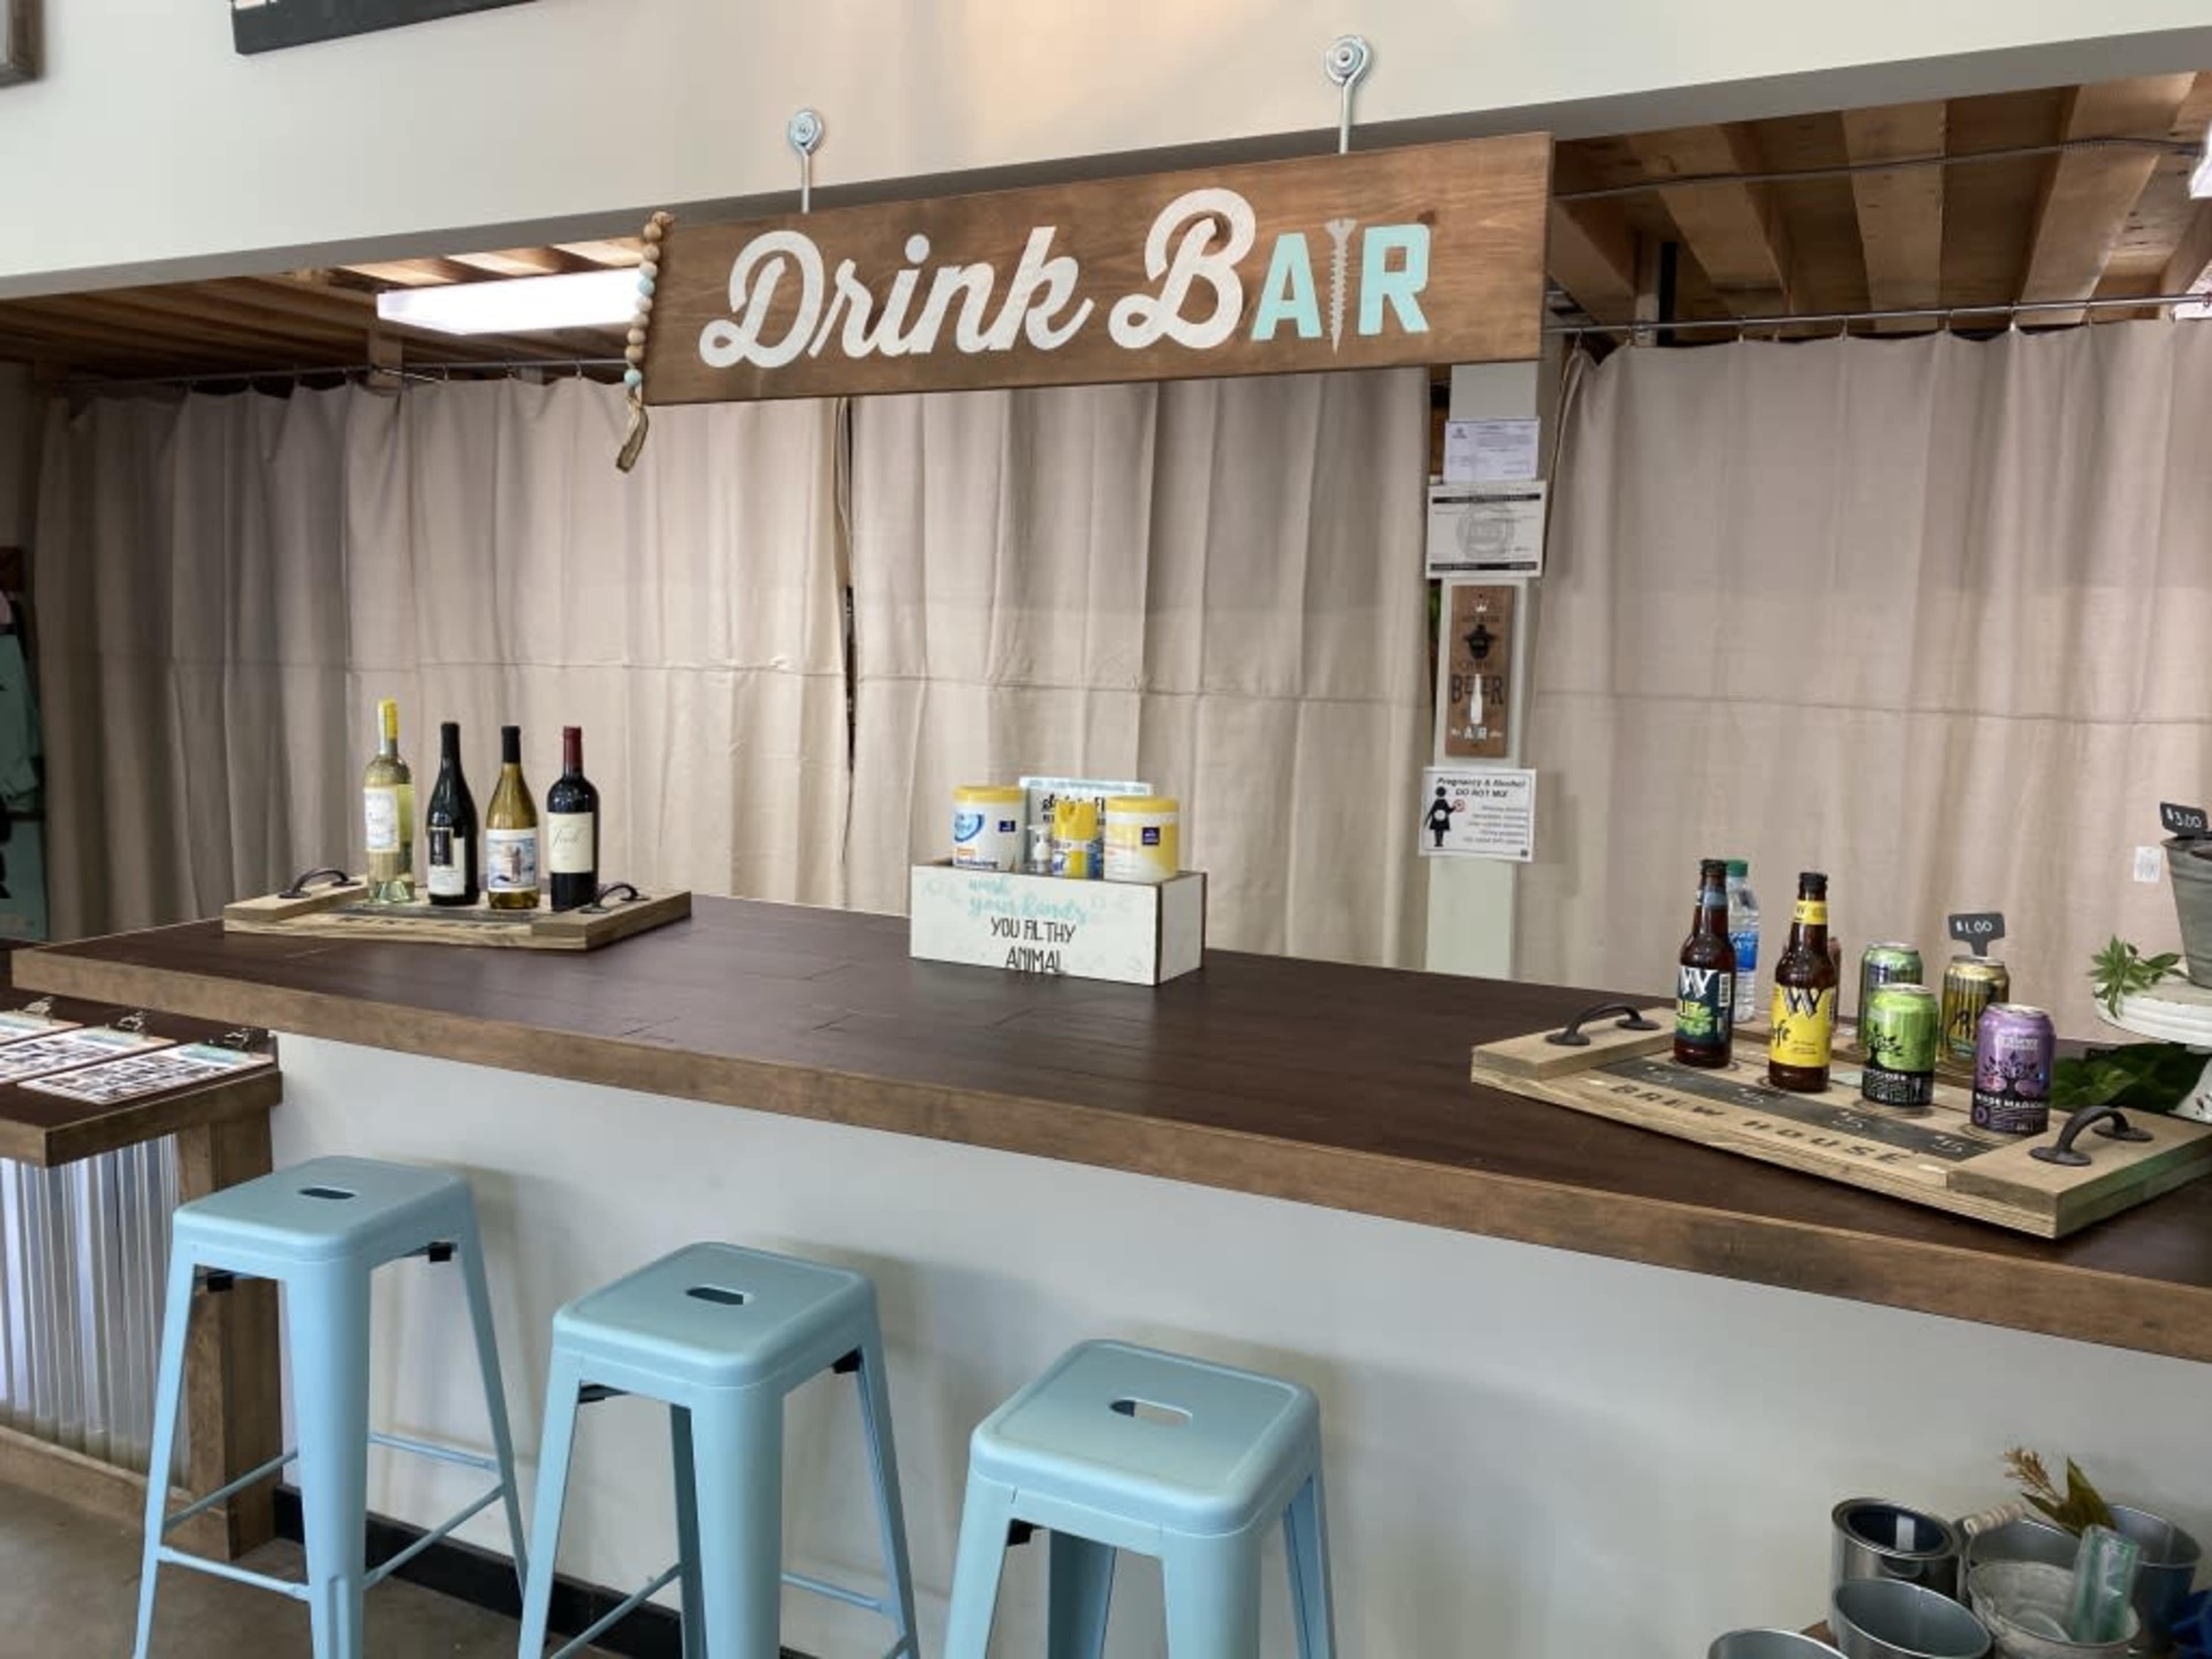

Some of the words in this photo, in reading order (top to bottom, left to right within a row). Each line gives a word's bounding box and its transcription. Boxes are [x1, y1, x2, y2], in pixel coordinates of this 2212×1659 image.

[699, 226, 1094, 369] Drink
[1451, 674, 1503, 705] BEER
[1436, 778, 1482, 787] Pregnancy
[1493, 779, 1525, 787] Alcohol
[1455, 788, 1469, 796] DO
[1472, 789, 1489, 797] NOT
[1493, 790, 1509, 798] MIX
[968, 897, 1014, 916] your
[1017, 892, 1090, 926] hands
[990, 915, 1020, 938] YOU
[1023, 918, 1077, 944] FILTHY
[1956, 920, 1993, 934] $1.00
[1005, 946, 1063, 975] ANIMAL
[1609, 1085, 1726, 1116] BREW
[1741, 1120, 1910, 1164] HOUSE
